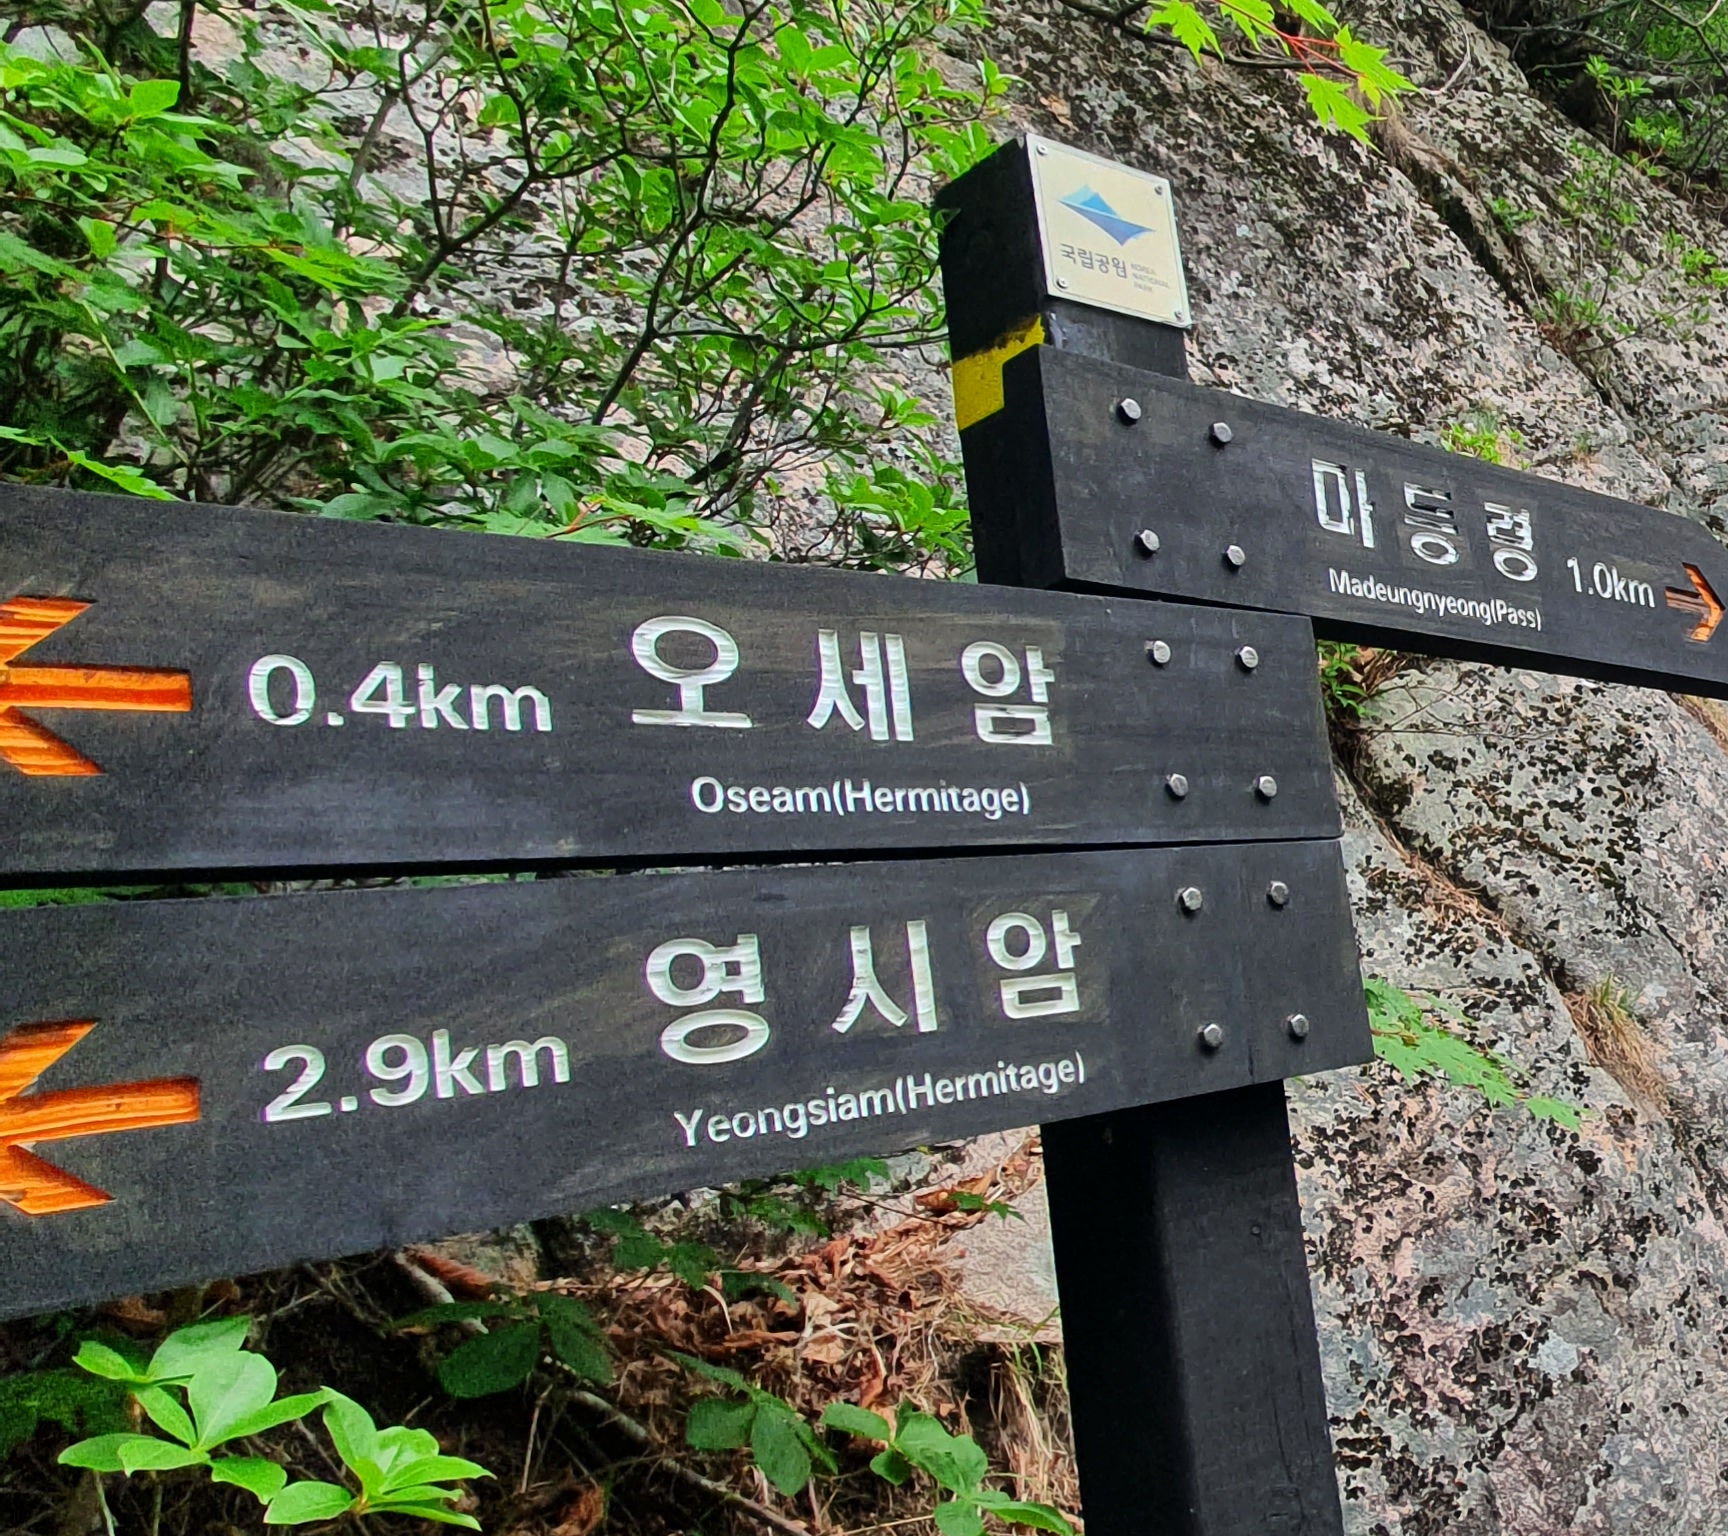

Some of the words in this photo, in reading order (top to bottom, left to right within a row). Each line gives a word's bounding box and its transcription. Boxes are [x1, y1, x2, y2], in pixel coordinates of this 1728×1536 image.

[1060, 243, 1127, 279] 국립공원
[1328, 567, 1542, 631] Madeungnyeong(Pass)
[1566, 556, 1656, 608] 1.0km
[248, 653, 553, 732] 0.4km
[630, 614, 1056, 746] 오세암
[690, 775, 1031, 819] Oseam(Hermitage)
[262, 1028, 571, 1123] 2.9km
[645, 909, 1083, 1065] 영시암
[673, 1051, 1087, 1148] Yeongsiam(Hermitage)
